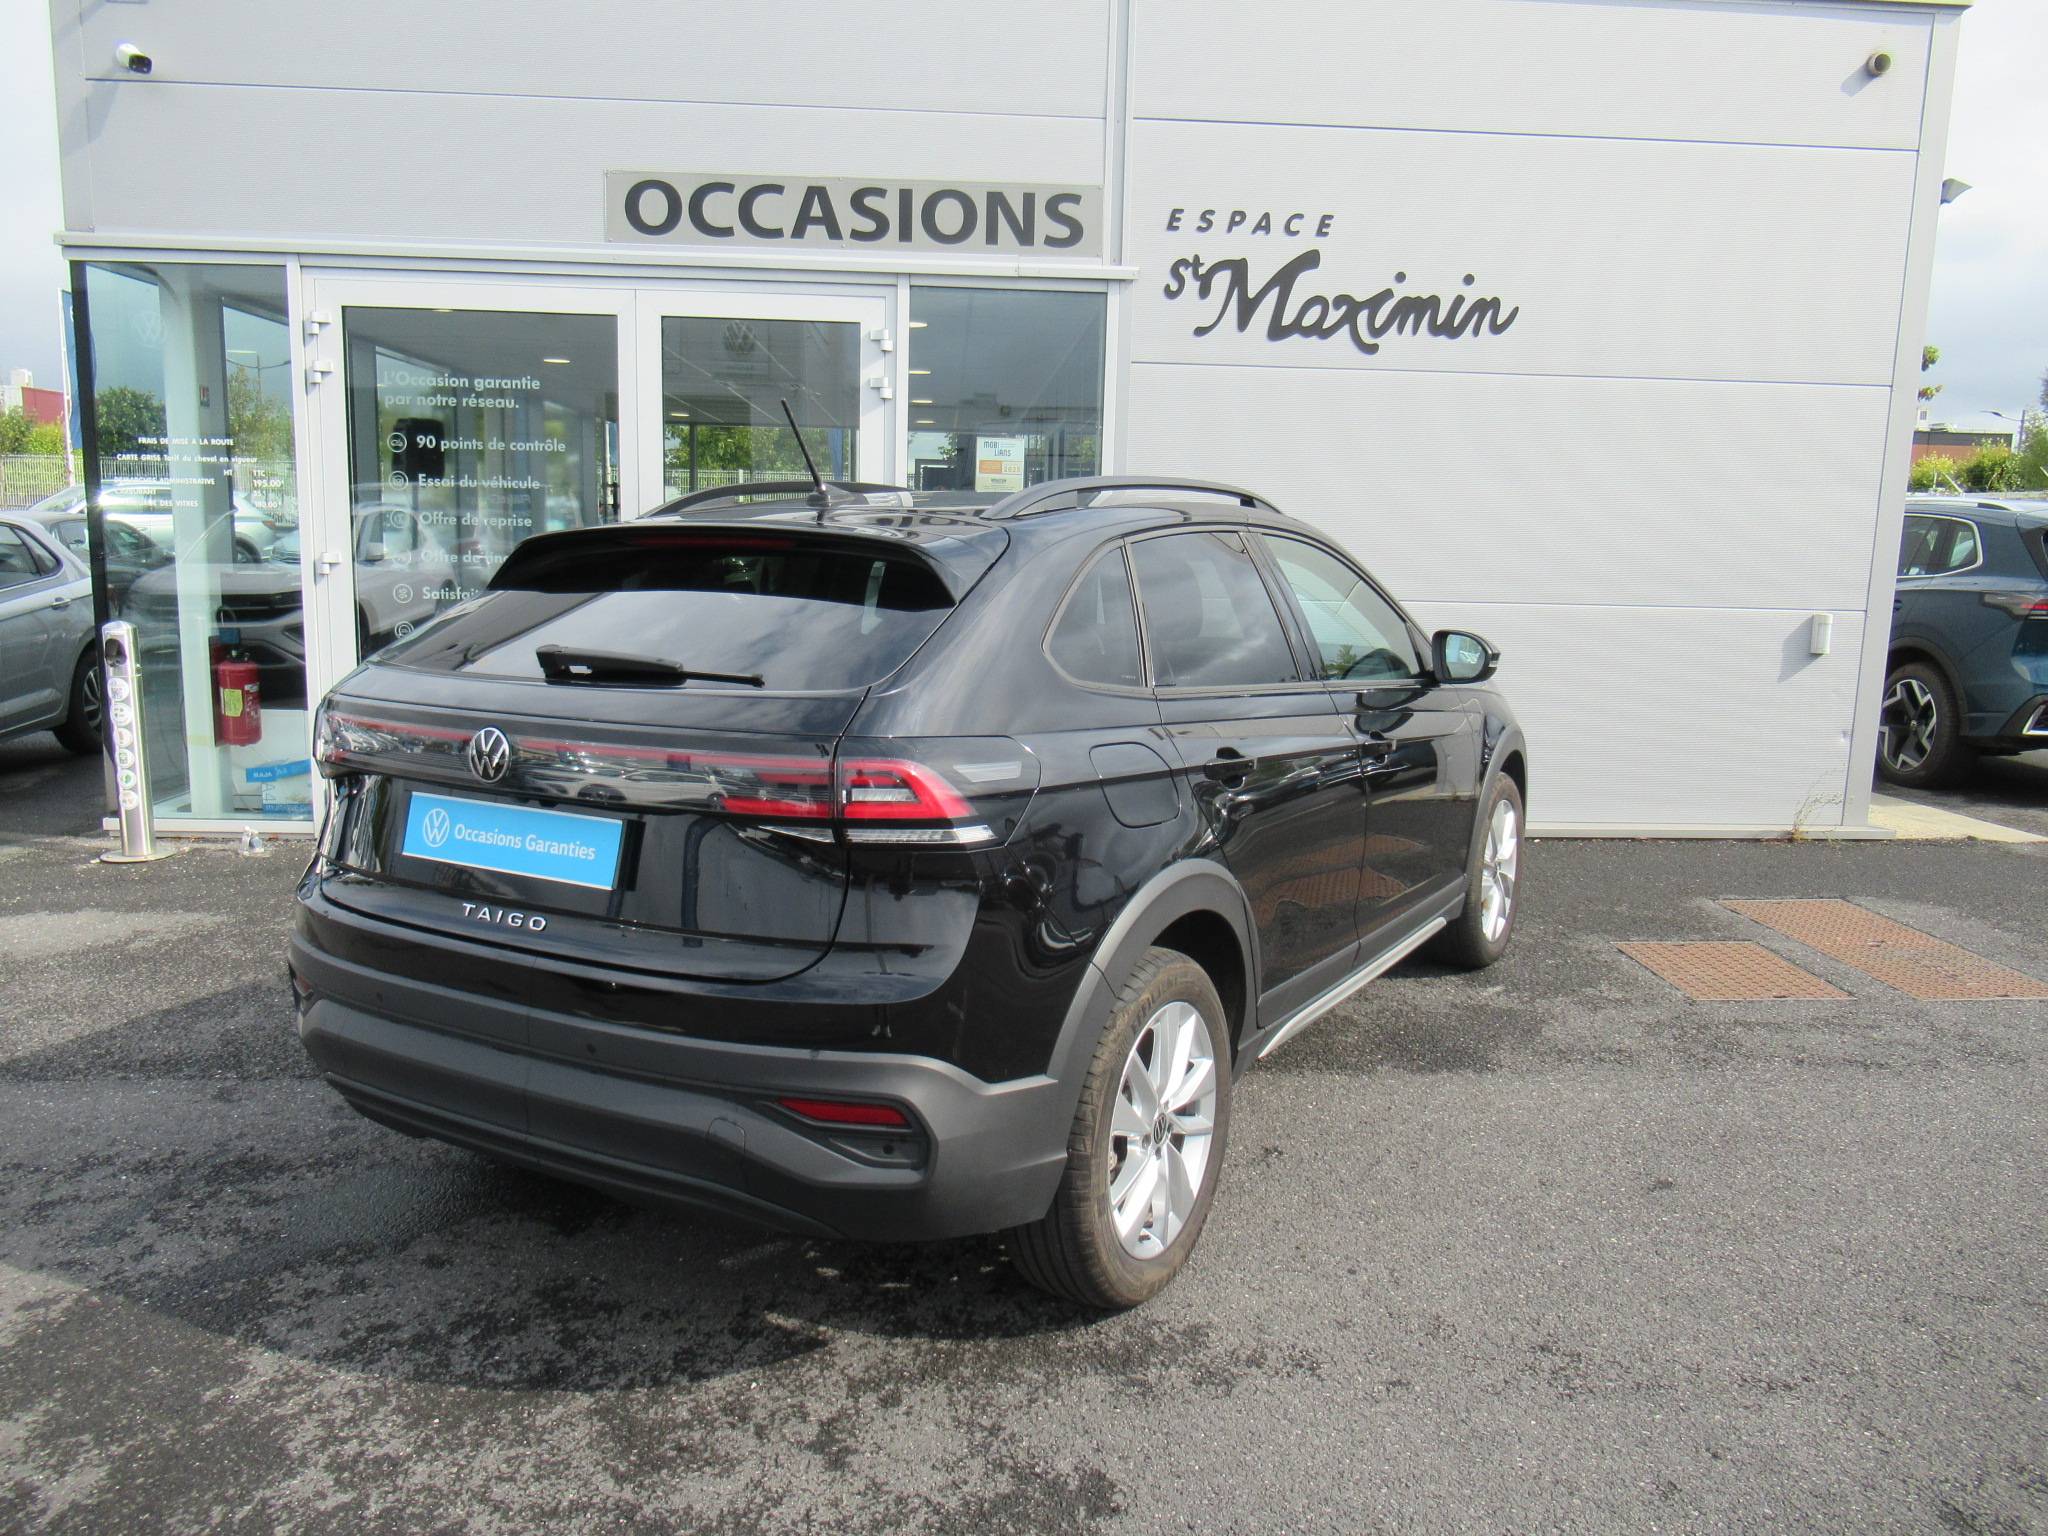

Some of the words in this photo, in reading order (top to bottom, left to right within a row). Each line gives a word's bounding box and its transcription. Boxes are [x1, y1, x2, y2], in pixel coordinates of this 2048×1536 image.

[624, 179, 1084, 249] OCCASIONS
[1166, 208, 1334, 237] ESPACE
[1164, 253, 1205, 300] St
[1193, 249, 1520, 355] Maximin
[384, 370, 469, 388] L'Occasion
[474, 375, 541, 392] garantie
[384, 395, 411, 408] par
[417, 394, 457, 407] notre
[462, 394, 520, 410] réseau.
[137, 437, 158, 445] FRAIS
[160, 437, 169, 445] DE
[199, 438, 209, 446] LA
[211, 438, 235, 447] ROUTE
[416, 435, 437, 449] 90
[440, 437, 484, 453] points
[488, 437, 506, 451] de
[509, 436, 567, 453] contrôle
[116, 453, 139, 461] CARTE
[418, 473, 455, 488] Essai
[459, 474, 478, 489] du
[481, 474, 541, 490] véhicule
[419, 511, 457, 526] Offre
[461, 512, 479, 526] de
[483, 513, 533, 529] reprise
[421, 549, 458, 564] Offre
[454, 823, 522, 849] Occasions
[525, 834, 596, 861] Garanties
[462, 902, 548, 932] TAIGO
